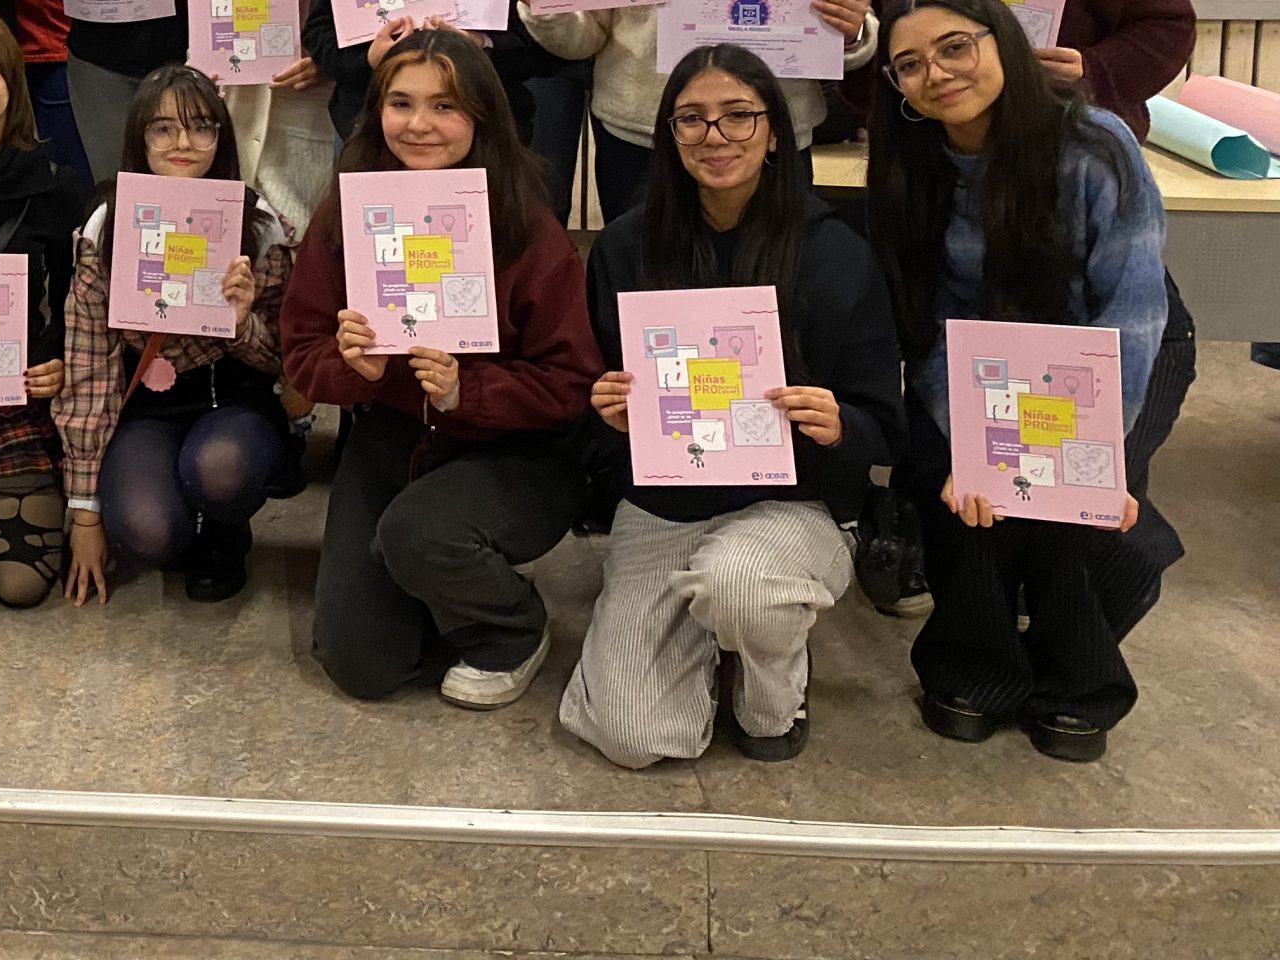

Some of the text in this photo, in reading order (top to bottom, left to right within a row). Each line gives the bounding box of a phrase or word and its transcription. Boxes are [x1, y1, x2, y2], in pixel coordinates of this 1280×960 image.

[408, 250, 438, 259] Niñas
[409, 260, 431, 269] PRO
[693, 374, 726, 384] Niñas
[694, 384, 718, 394] PRO
[1023, 409, 1059, 422] Niñas
[1024, 420, 1050, 431] PRO
